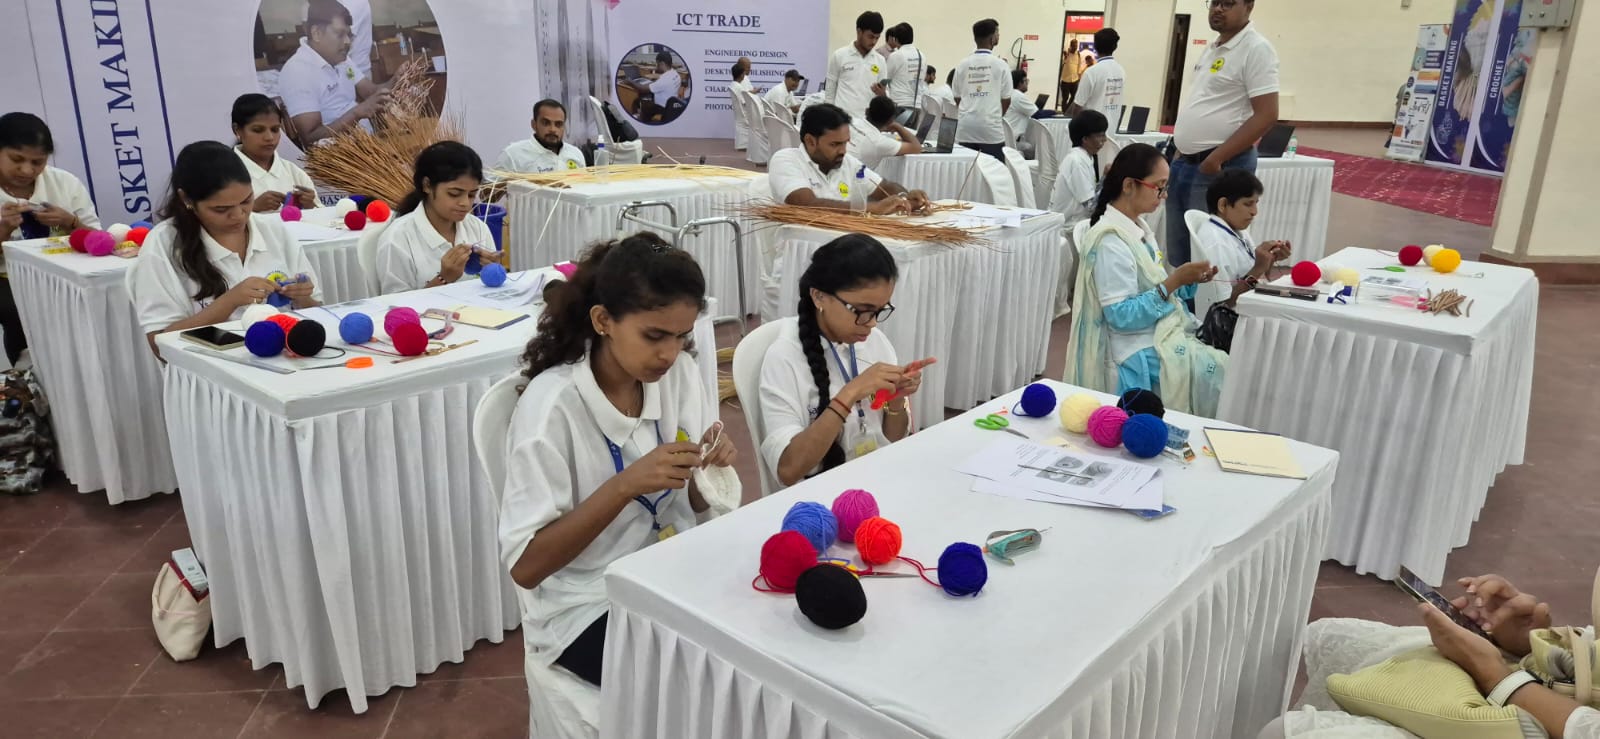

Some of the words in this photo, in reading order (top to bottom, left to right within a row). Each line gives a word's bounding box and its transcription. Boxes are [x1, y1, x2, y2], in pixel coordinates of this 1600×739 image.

[676, 12, 703, 26] ICT
[706, 14, 761, 28] TRADE
[90, 0, 135, 114] MAKI
[704, 49, 758, 58] ENGINEERING
[704, 68, 732, 76] DESKT
[750, 69, 785, 77] BLISHING
[1438, 76, 1451, 107] BASKET
[1445, 40, 1458, 73] MAKING
[1489, 59, 1504, 98] CROCHET
[111, 122, 153, 224] SKET
